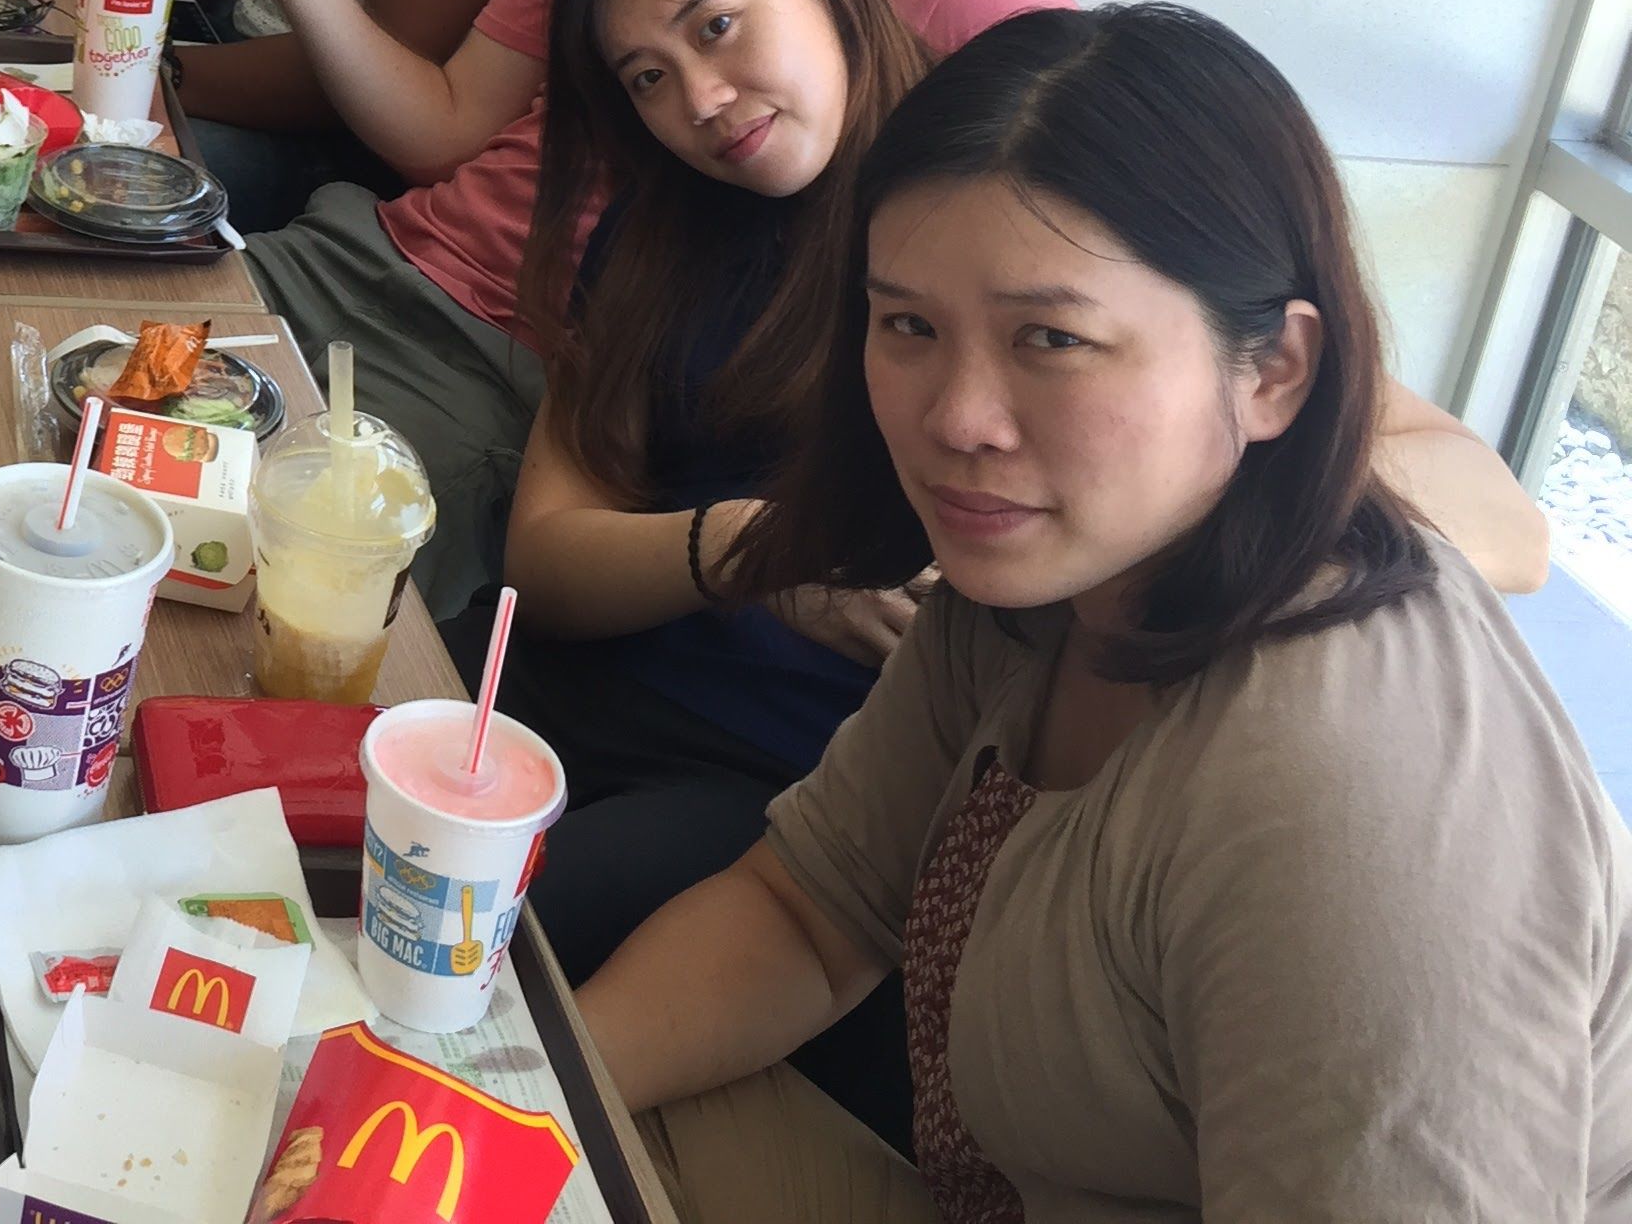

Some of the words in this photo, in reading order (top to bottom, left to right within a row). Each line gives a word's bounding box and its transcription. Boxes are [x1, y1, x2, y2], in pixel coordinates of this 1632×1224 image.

[104, 25, 143, 53] GOOD
[88, 45, 152, 71] together
[370, 915, 389, 944] BIG
